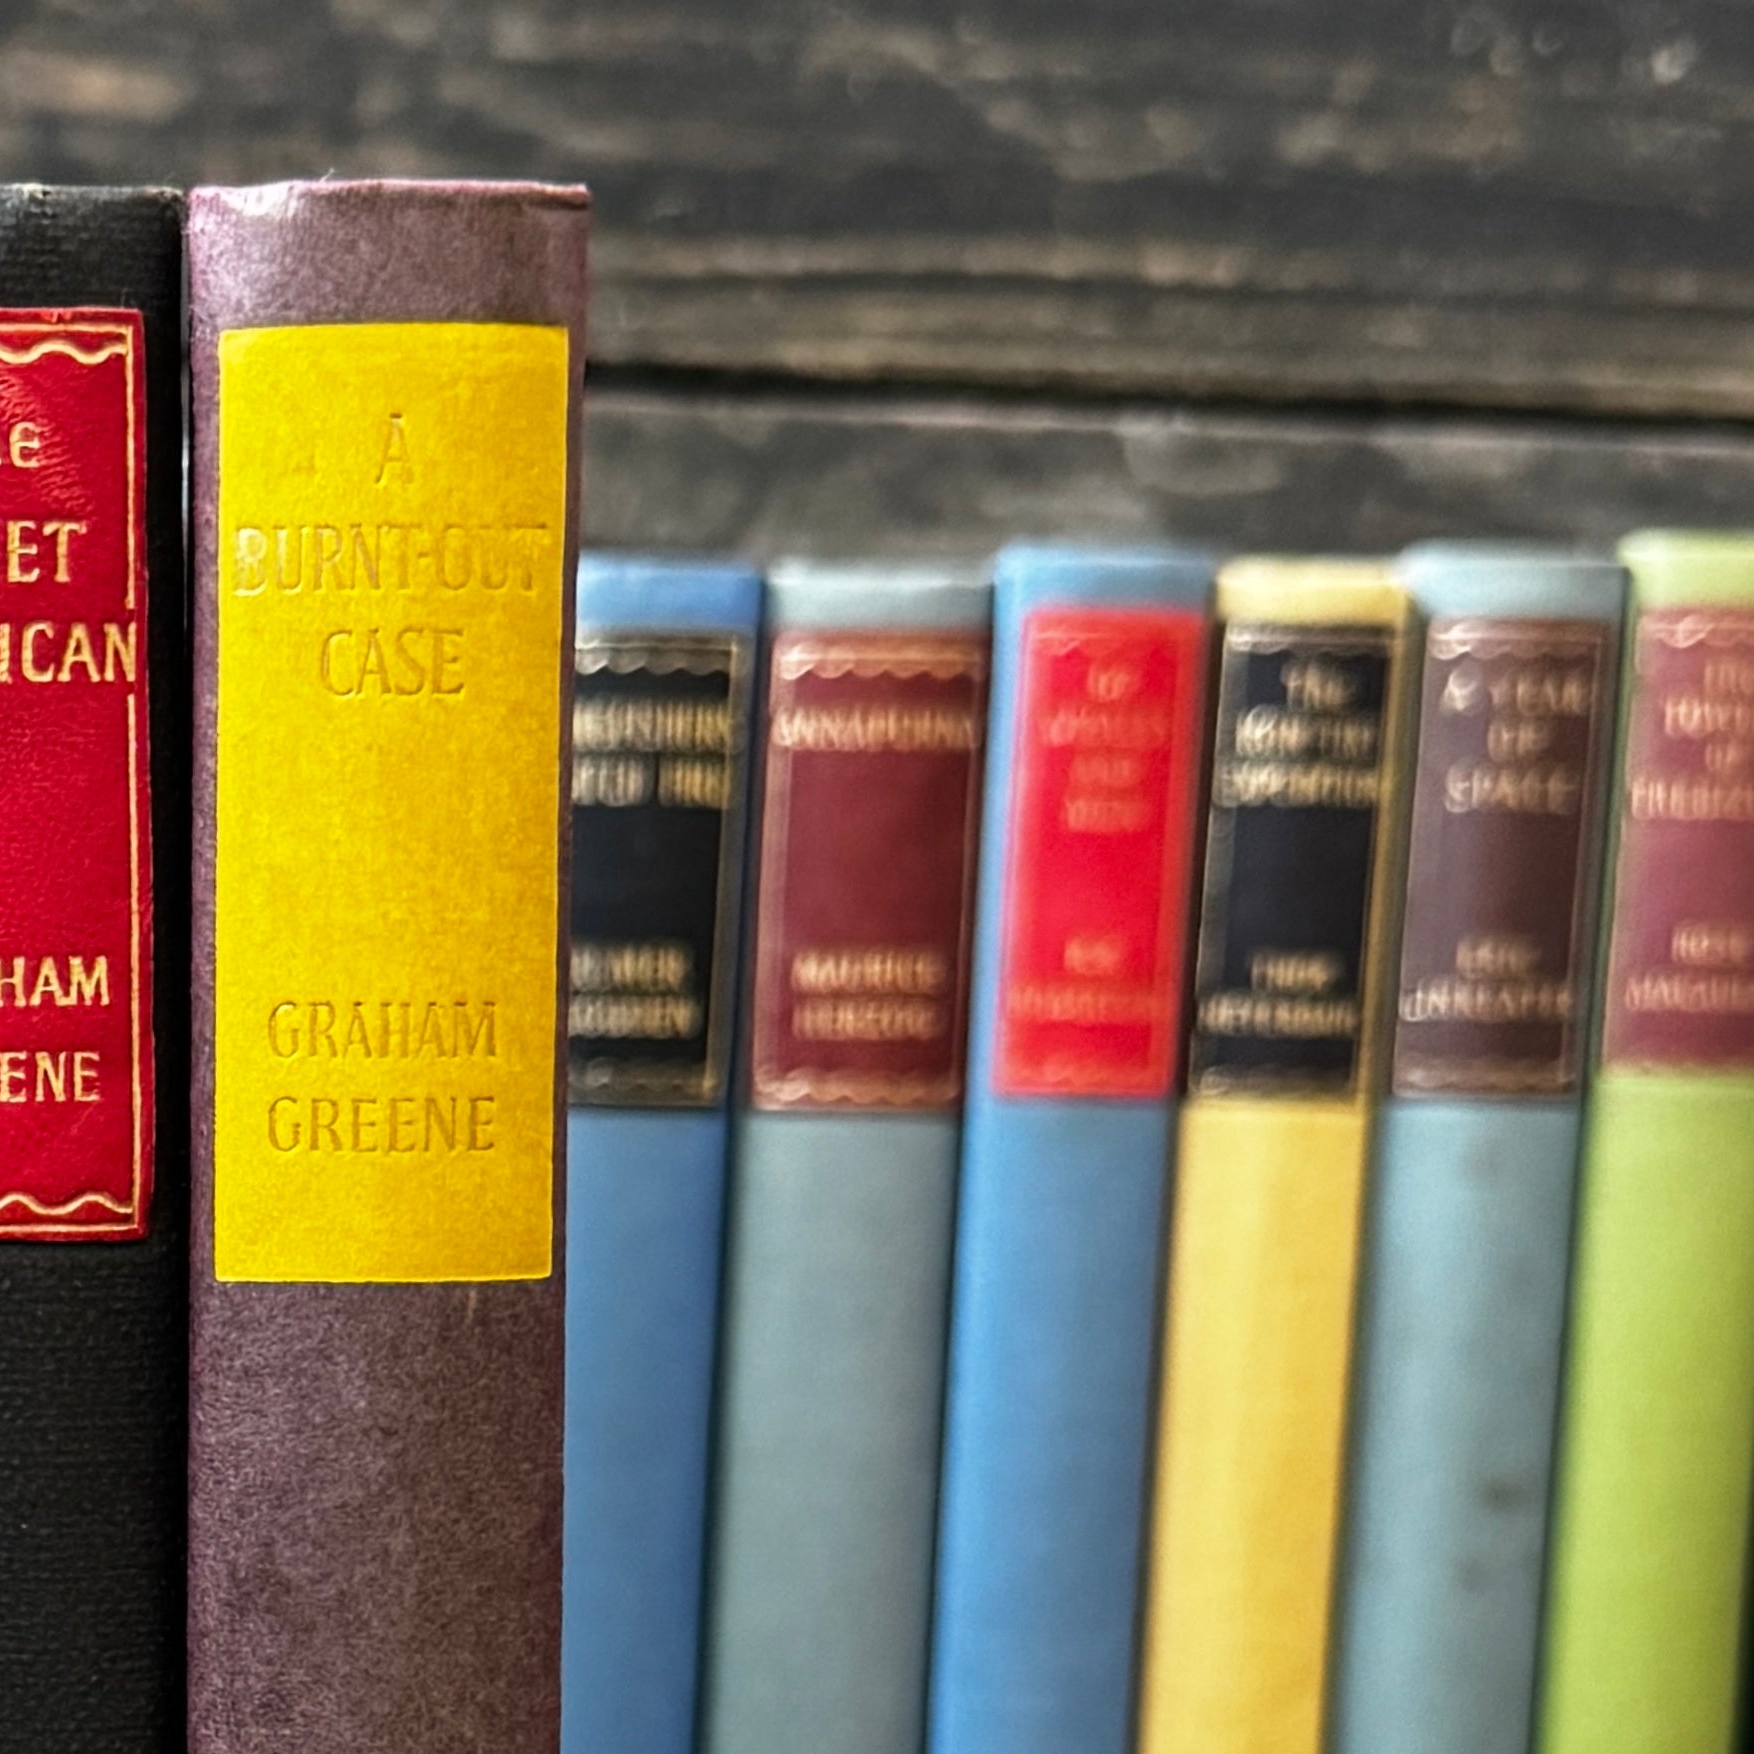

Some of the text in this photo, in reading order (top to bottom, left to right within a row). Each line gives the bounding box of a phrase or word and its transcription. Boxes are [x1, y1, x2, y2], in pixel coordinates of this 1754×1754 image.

[375, 412, 414, 486] A
[234, 522, 548, 597] BURNT-OUT
[319, 627, 465, 698] CASE
[267, 1001, 498, 1060] GRAHAM
[267, 1096, 496, 1153] GREENE
